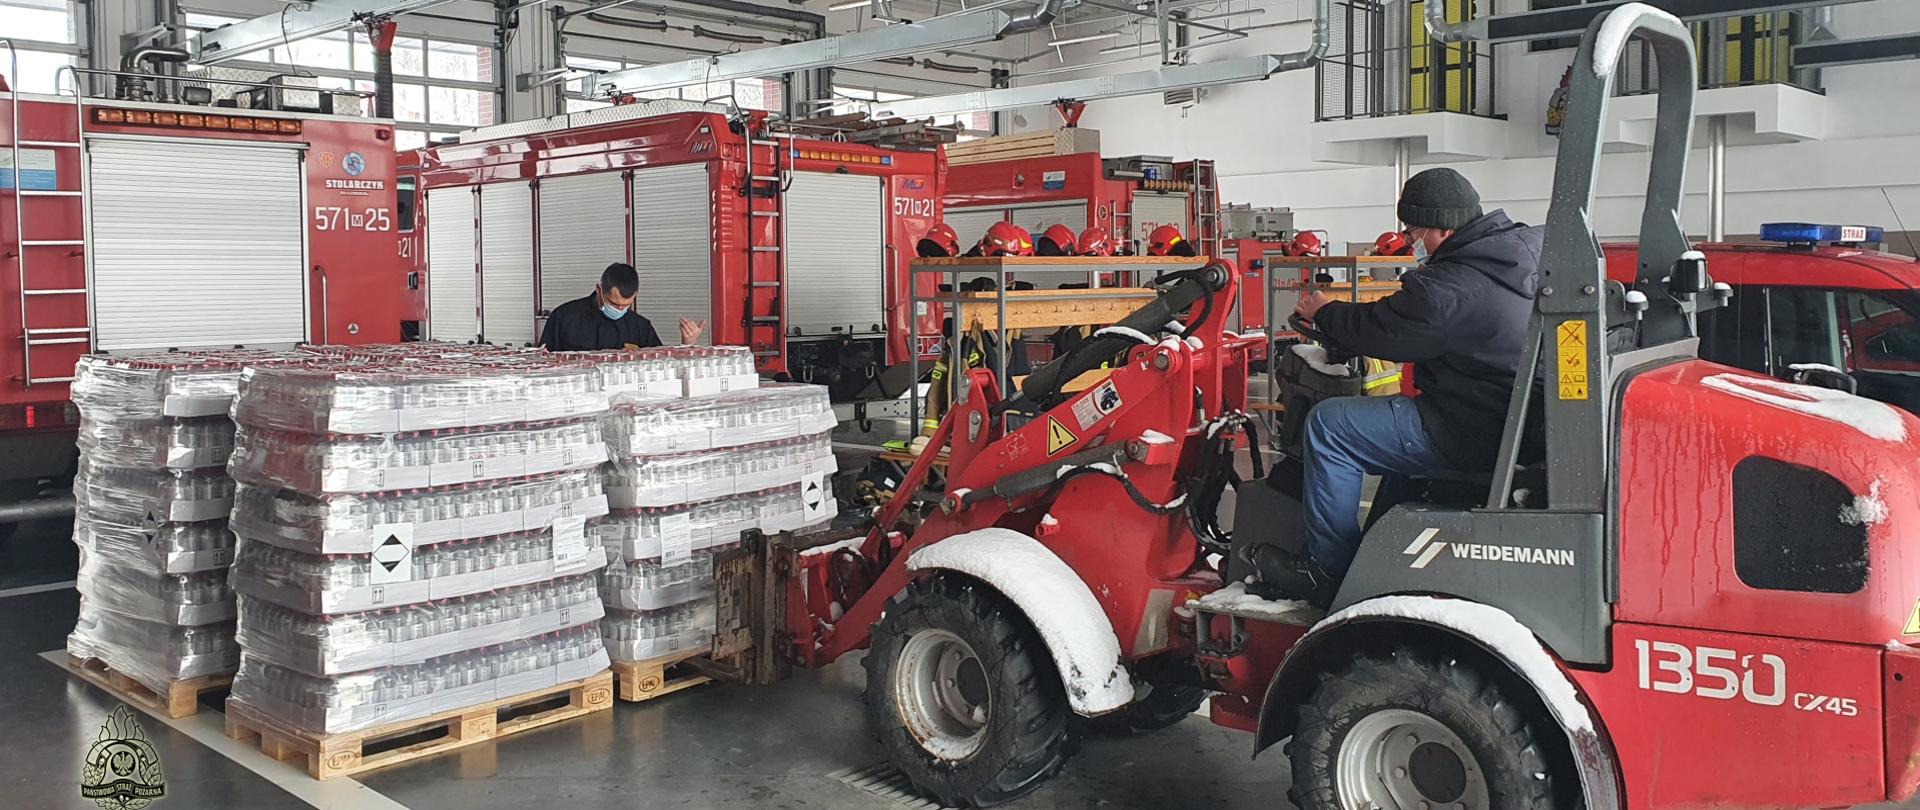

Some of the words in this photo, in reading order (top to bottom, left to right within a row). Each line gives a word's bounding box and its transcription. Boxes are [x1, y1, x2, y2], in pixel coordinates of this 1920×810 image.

[325, 179, 384, 190] STOLARCZYK
[1450, 542, 1575, 566] WEIDEMANN
[1635, 639, 1787, 706] 1350
[1794, 692, 1858, 717] CX45
